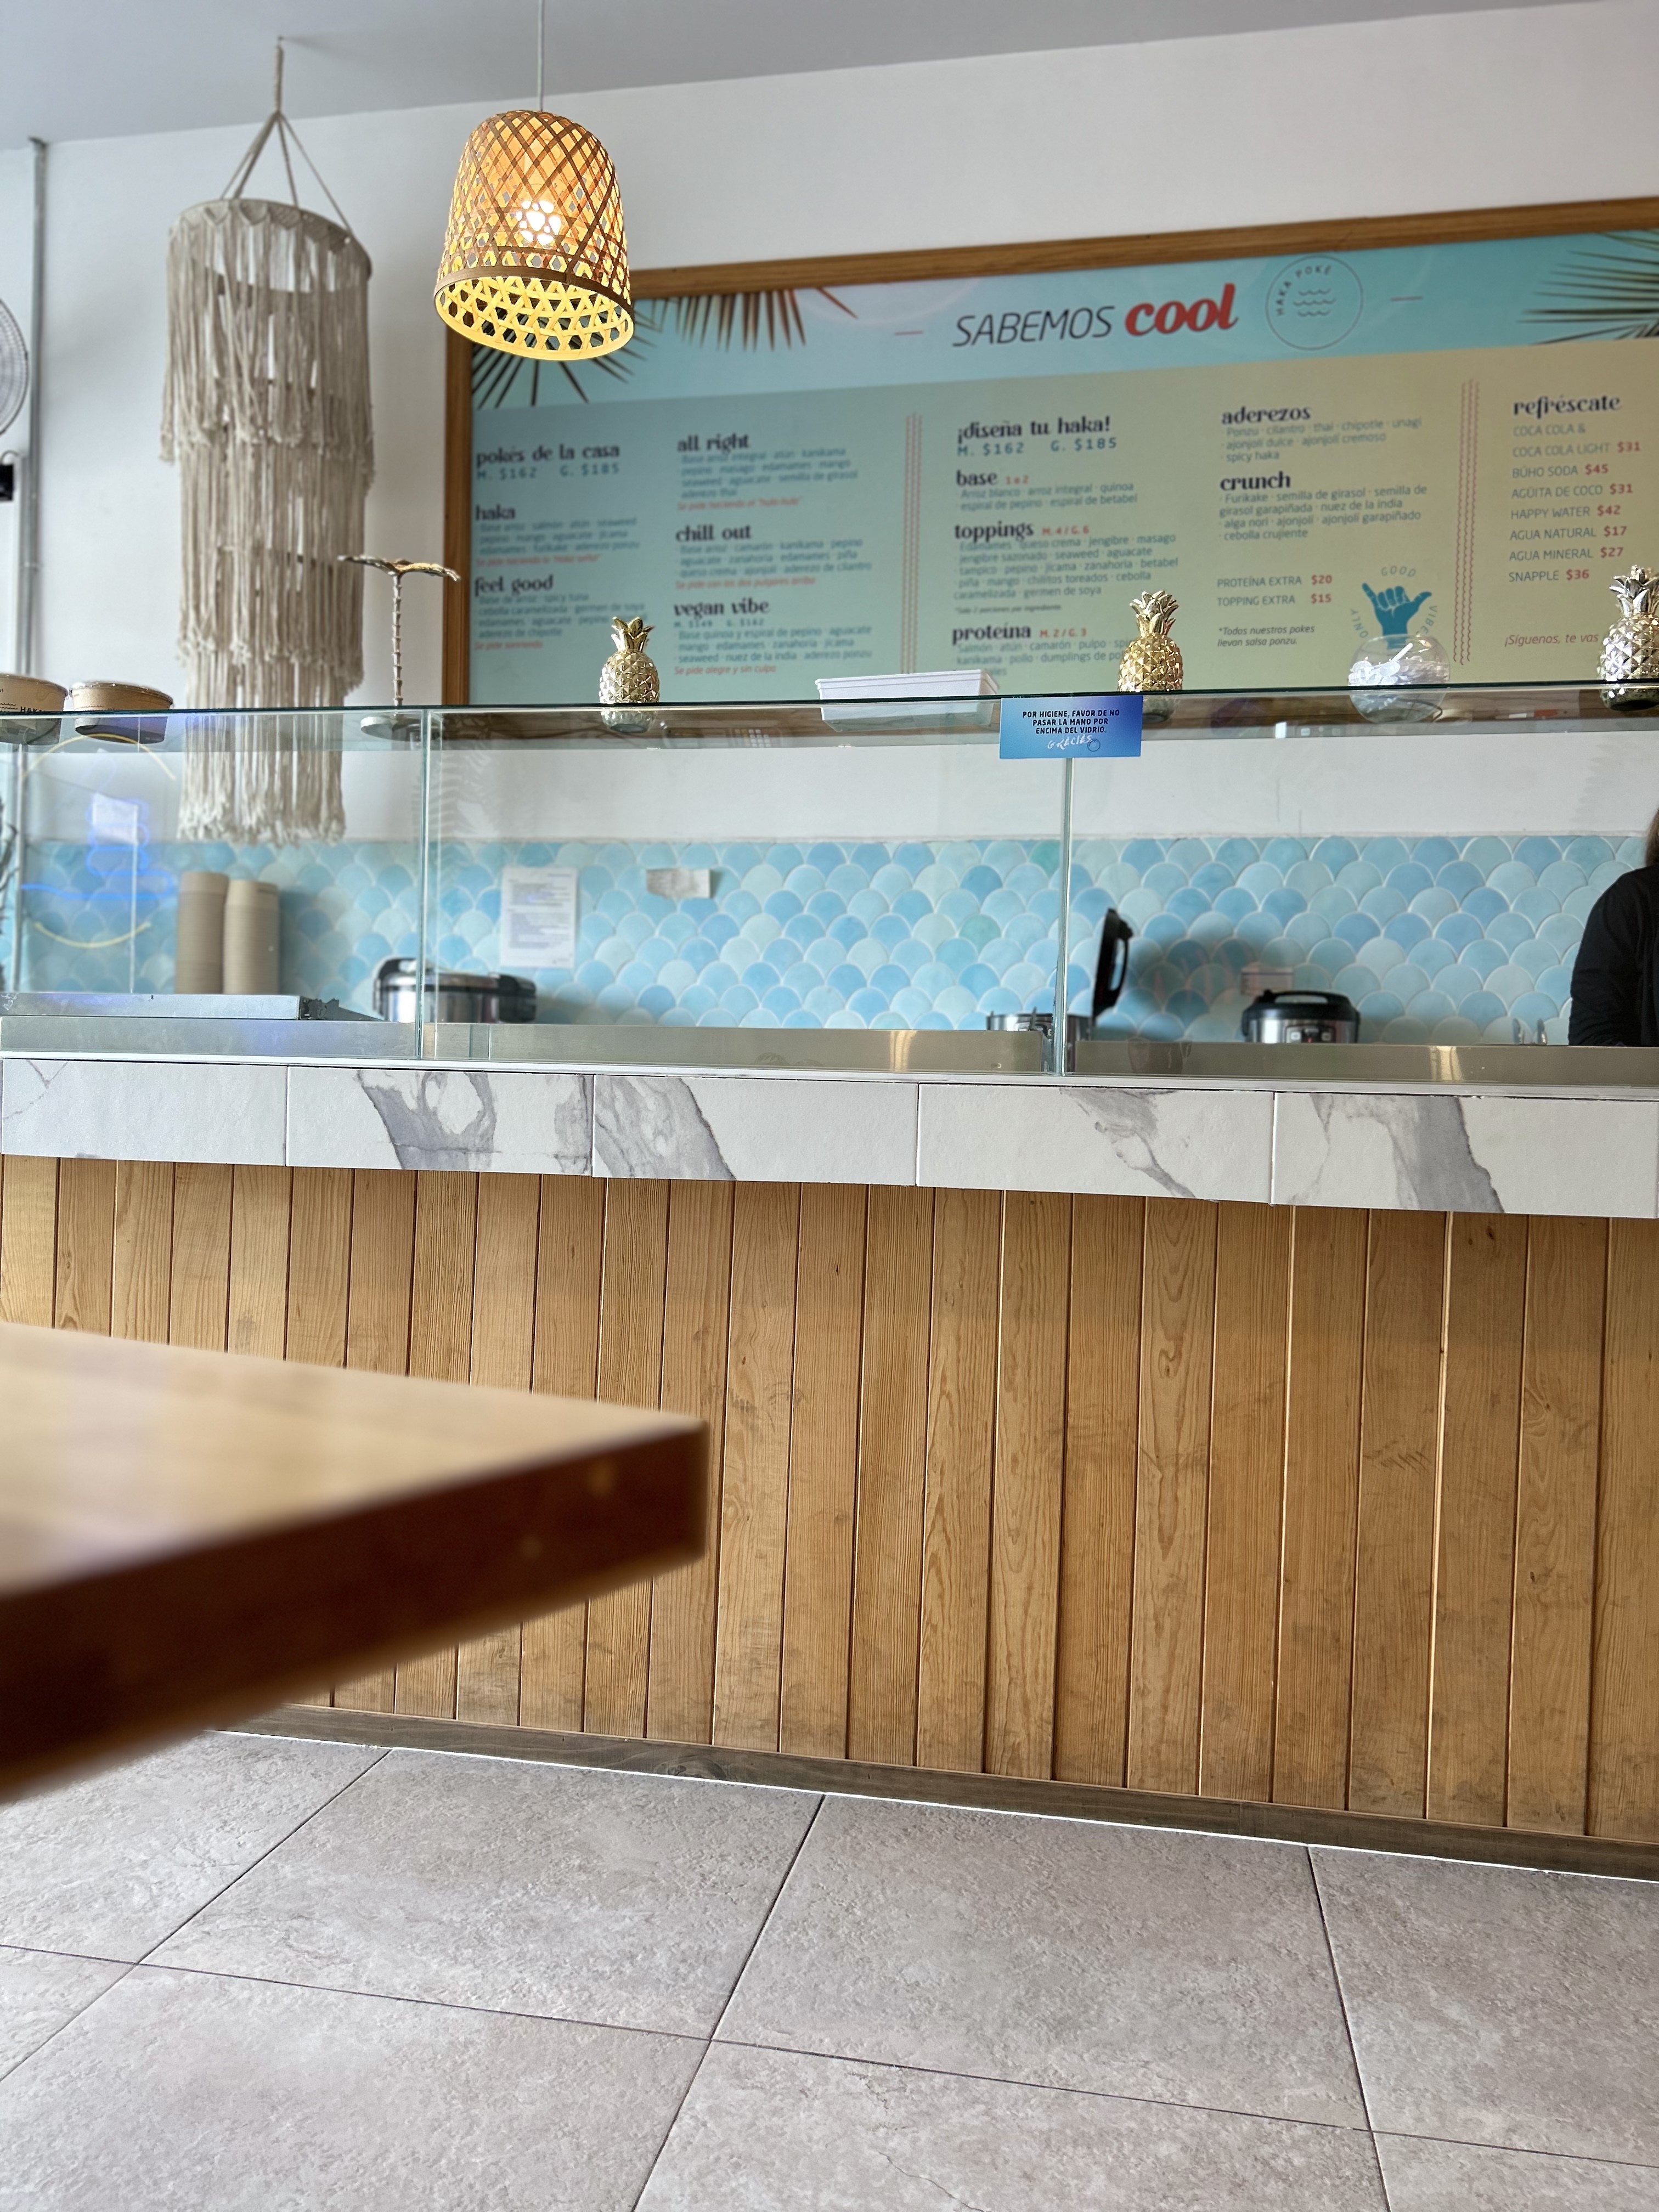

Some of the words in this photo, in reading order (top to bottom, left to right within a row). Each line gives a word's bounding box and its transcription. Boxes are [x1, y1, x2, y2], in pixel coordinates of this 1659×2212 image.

[952, 306, 1115, 347] SABEMOS
[1125, 283, 1238, 337] cool
[1513, 394, 1621, 420] refréscate
[1221, 406, 1311, 425] aderezos
[957, 421, 1022, 444] ¡diseña
[1030, 421, 1050, 436] tu
[1058, 415, 1110, 434] haka!
[1513, 426, 1542, 437] COCA
[1545, 424, 1575, 435] COLA
[678, 435, 700, 452] all
[707, 433, 750, 454] right
[957, 445, 975, 456] M.
[983, 442, 1025, 456] $162
[1051, 440, 1066, 453] G.
[1075, 437, 1117, 452] $185
[1513, 447, 1542, 458] COCA
[1545, 444, 1575, 456] COLA
[1577, 442, 1610, 454] LIGHT
[1617, 441, 1641, 453] $31
[532, 445, 553, 461] de
[560, 444, 575, 459] la
[582, 445, 620, 459] casa
[1226, 450, 1252, 464] spicy
[1255, 449, 1280, 460] haka
[499, 467, 538, 480] $162
[956, 470, 998, 486] base
[1512, 465, 1544, 478] BÚHO
[1547, 465, 1578, 477] SODA
[1585, 464, 1609, 475] $45
[1220, 470, 1291, 490] crunch
[1225, 491, 1268, 503] Furikake
[1276, 489, 1312, 501] semilla
[1314, 488, 1328, 499] de
[1331, 486, 1366, 501] girasol
[1374, 484, 1411, 496] semilla
[1414, 483, 1427, 494] de
[1511, 486, 1553, 499] AGÜITA
[1555, 486, 1571, 497] DE
[1573, 484, 1604, 496] COCO
[1610, 483, 1633, 495] $31
[476, 504, 516, 520] haka
[1219, 504, 1253, 518] girasol
[1255, 501, 1312, 517] garapiñada
[1321, 502, 1346, 511] nuez
[1349, 499, 1362, 510] de
[1365, 498, 1374, 509] la
[1377, 497, 1403, 509] india
[1511, 509, 1549, 520] HAPPY
[1552, 506, 1590, 518] WATER
[1597, 504, 1621, 516] $42
[1224, 517, 1246, 531] alga
[1249, 515, 1268, 527] nori
[1362, 510, 1421, 525] garapiñado
[675, 524, 714, 542] chill
[722, 525, 752, 540] out
[955, 520, 1034, 544] toppings
[1224, 529, 1260, 540] cebolla
[1262, 527, 1308, 541] crujiente
[1510, 530, 1541, 540] AGUA
[1544, 528, 1597, 539] NATURAL
[1604, 525, 1627, 537] $17
[1137, 535, 1176, 546] masago
[1106, 546, 1153, 560] aguacate
[1509, 551, 1540, 561] AGUA
[1543, 549, 1594, 560] MINERAL
[1600, 546, 1624, 558] $27
[1084, 559, 1133, 571] zanahoria
[1140, 557, 1178, 568] betabel
[1381, 565, 1416, 577] GOOD
[1065, 572, 1108, 583] toreados
[1116, 570, 1152, 582] cebolla
[1217, 576, 1266, 588] PROTEÍNA
[1268, 575, 1302, 586] EXTRA
[1311, 574, 1333, 585] $20
[1509, 570, 1560, 582] SNAPPLE
[1566, 568, 1590, 581] $36
[475, 576, 504, 596] feel
[511, 574, 554, 595] good
[1064, 585, 1076, 596] de
[1079, 586, 1101, 597] soya
[1217, 596, 1260, 607] TOPPING
[1262, 595, 1295, 605] EXTRA
[1311, 593, 1332, 604] $15
[673, 602, 724, 620] vegan
[731, 597, 770, 615] vibe
[1250, 626, 1287, 635] nuestros
[1289, 625, 1315, 636] pokes
[1350, 608, 1369, 638] ONLY
[952, 622, 1031, 645] proteína
[1504, 634, 1561, 647] ¡Síguenos,
[1565, 634, 1576, 644] te
[1581, 634, 1599, 642] vas
[1079, 638, 1106, 652] pulpo
[1217, 638, 1243, 647] llevan
[1245, 637, 1267, 646] salsa
[1269, 637, 1297, 648] ponzu.
[1042, 651, 1091, 665] dumplings
[1094, 650, 1106, 661] de
[1047, 734, 1093, 750] GRACIAS
